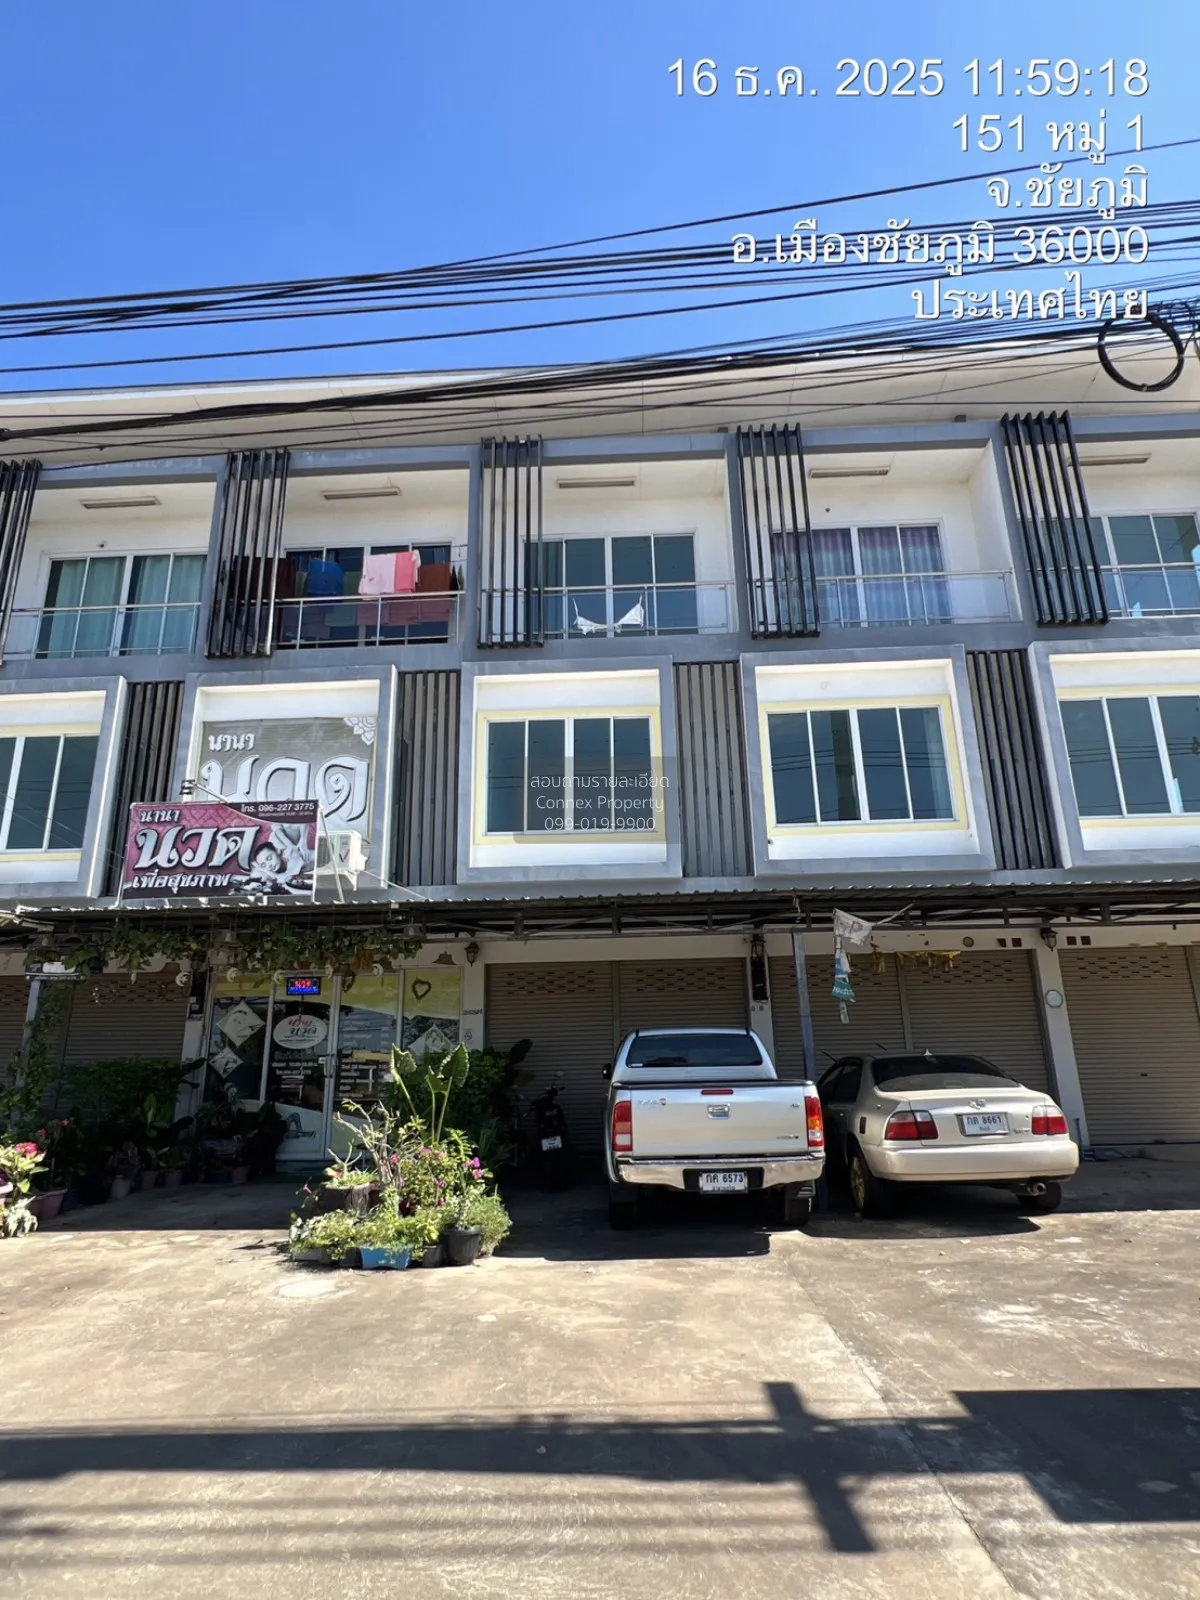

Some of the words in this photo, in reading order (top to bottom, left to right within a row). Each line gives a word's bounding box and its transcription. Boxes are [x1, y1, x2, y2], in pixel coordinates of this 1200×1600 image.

[207, 732, 255, 751] นานา
[258, 803, 293, 812] 096-227
[294, 802, 315, 811] 3775
[140, 809, 179, 824] นานา
[133, 825, 261, 870] นวด
[132, 868, 231, 894] เพื่อสุขภาพ
[722, 1173, 744, 1183] 6573
